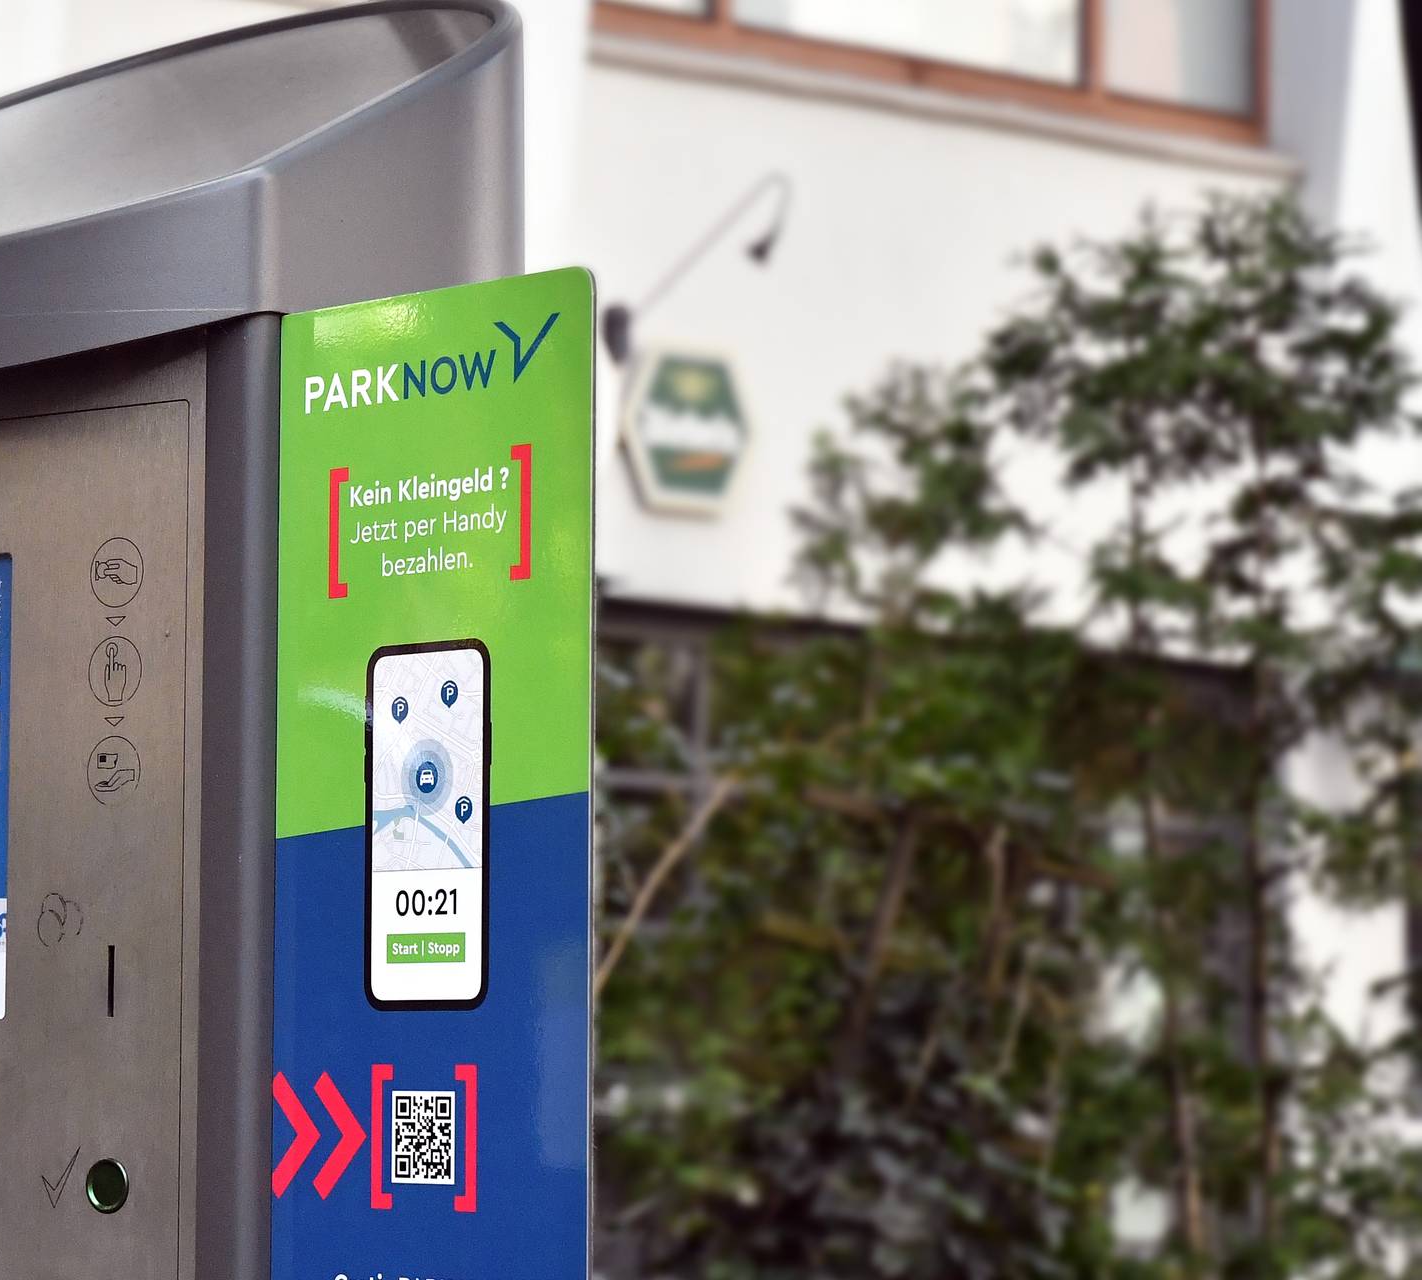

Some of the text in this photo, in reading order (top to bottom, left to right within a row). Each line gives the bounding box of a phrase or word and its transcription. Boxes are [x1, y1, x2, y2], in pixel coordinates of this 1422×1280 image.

[349, 466, 509, 507] Kein Kleingeld ?
[350, 504, 507, 544] Jetzt per Handy
[381, 546, 473, 577] bezahlen.
[395, 888, 458, 917] 00:21
[392, 943, 419, 955] Start
[428, 942, 460, 957] Stopp
